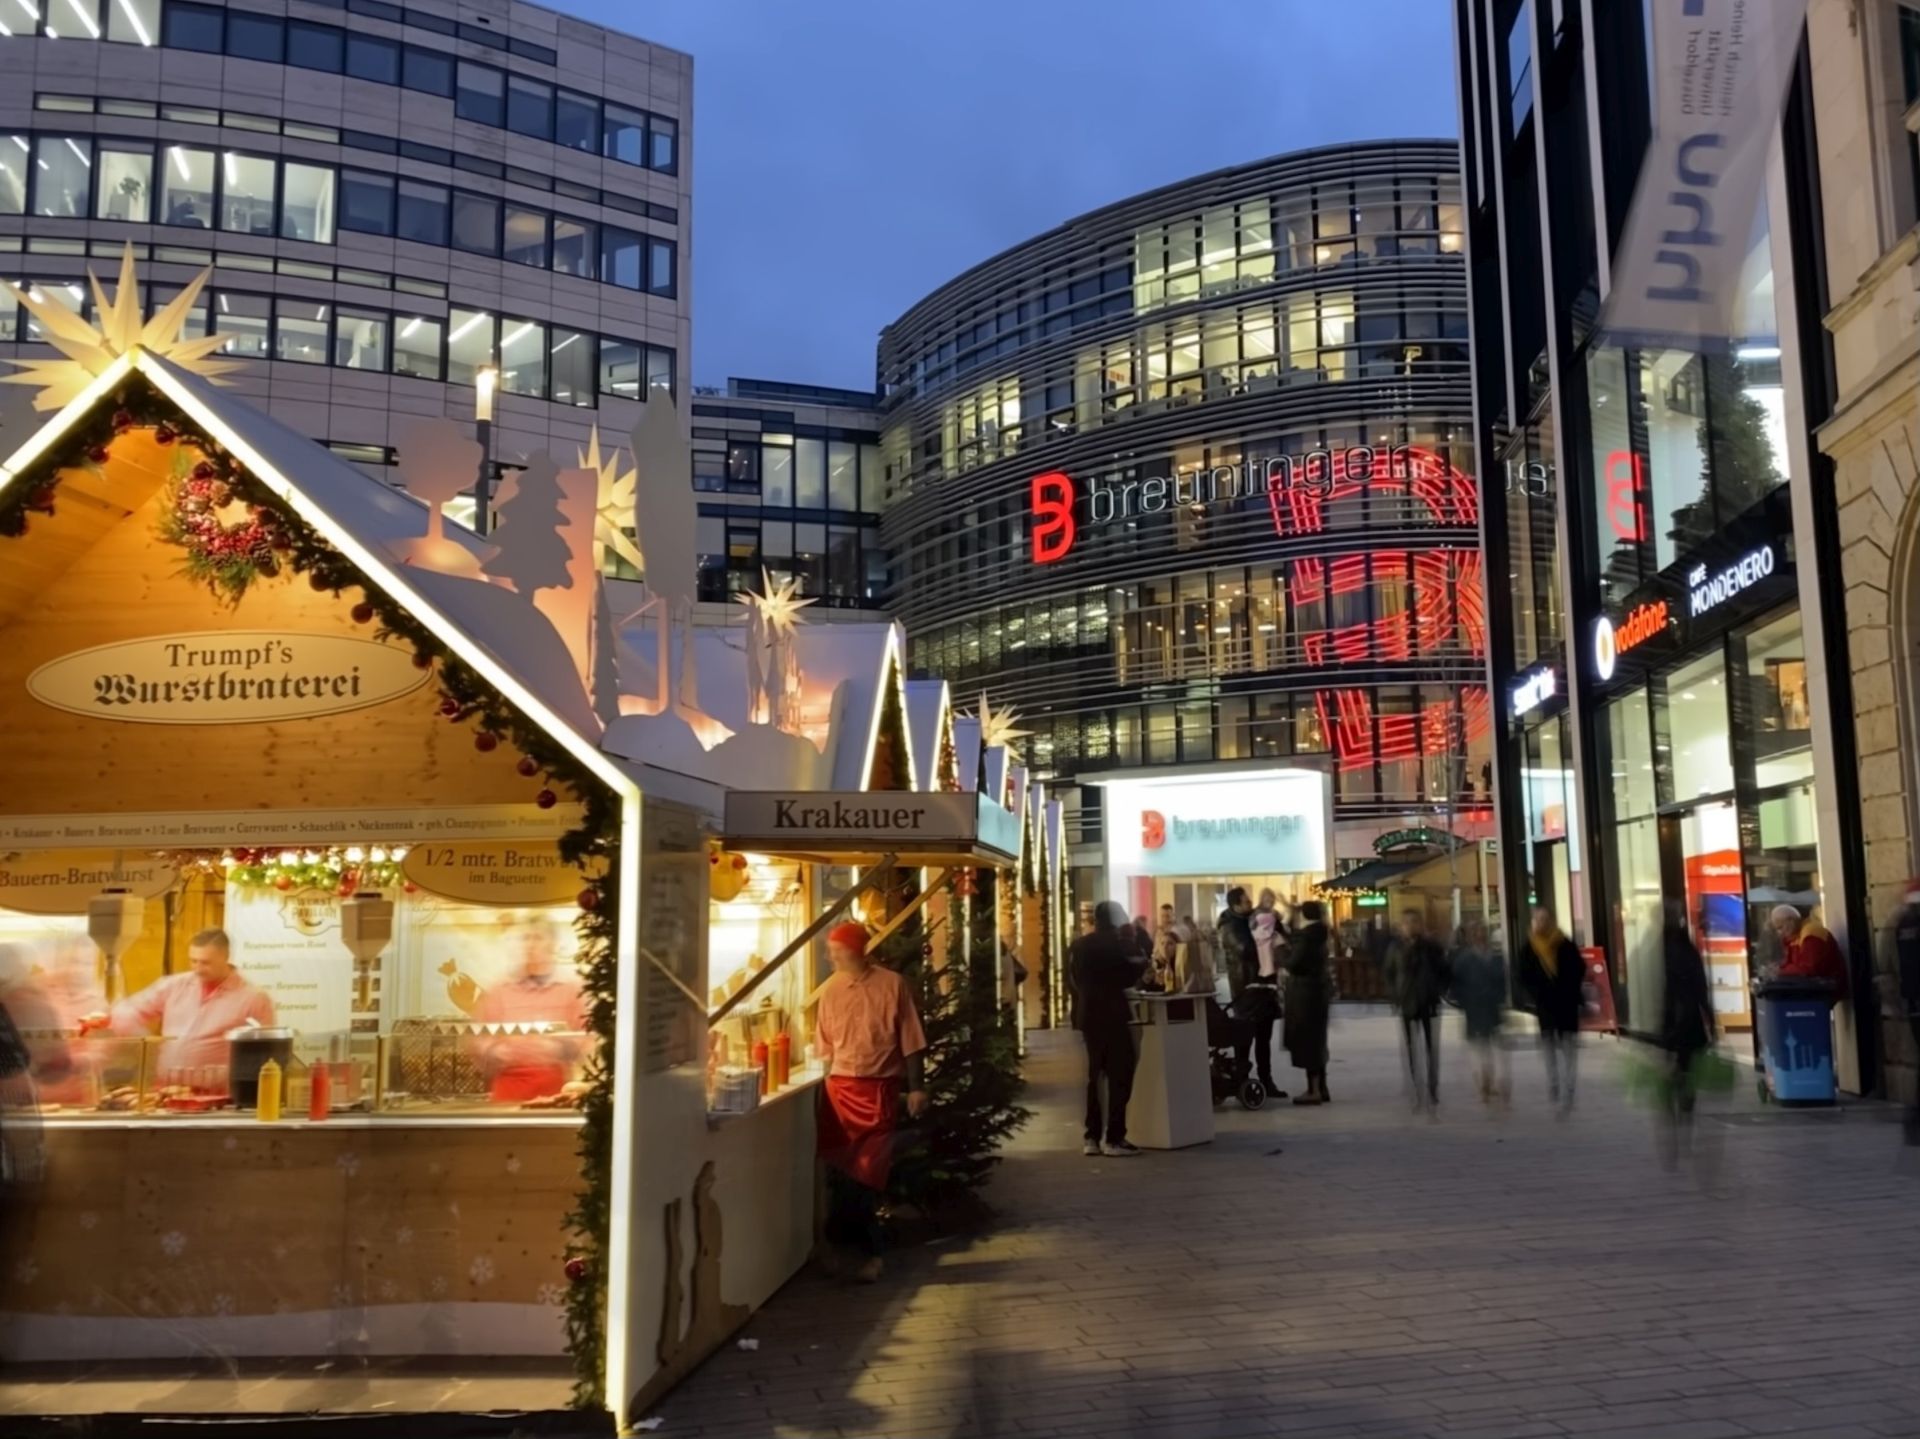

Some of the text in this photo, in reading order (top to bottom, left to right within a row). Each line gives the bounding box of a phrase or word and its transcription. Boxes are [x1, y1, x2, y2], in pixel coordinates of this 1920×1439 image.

[1087, 444, 1411, 526] breuninger
[1691, 545, 1775, 617] MONDENERO
[1614, 601, 1668, 654] vodafone
[165, 640, 293, 670] Trumpf's
[93, 667, 361, 706] Wurstbraterei
[236, 821, 289, 835] Currywurst
[299, 819, 346, 832] Schaschlik
[773, 799, 925, 829] Krakauer
[425, 849, 455, 868] 1/2
[461, 850, 497, 868] mtr.
[469, 871, 546, 886] im Baguette
